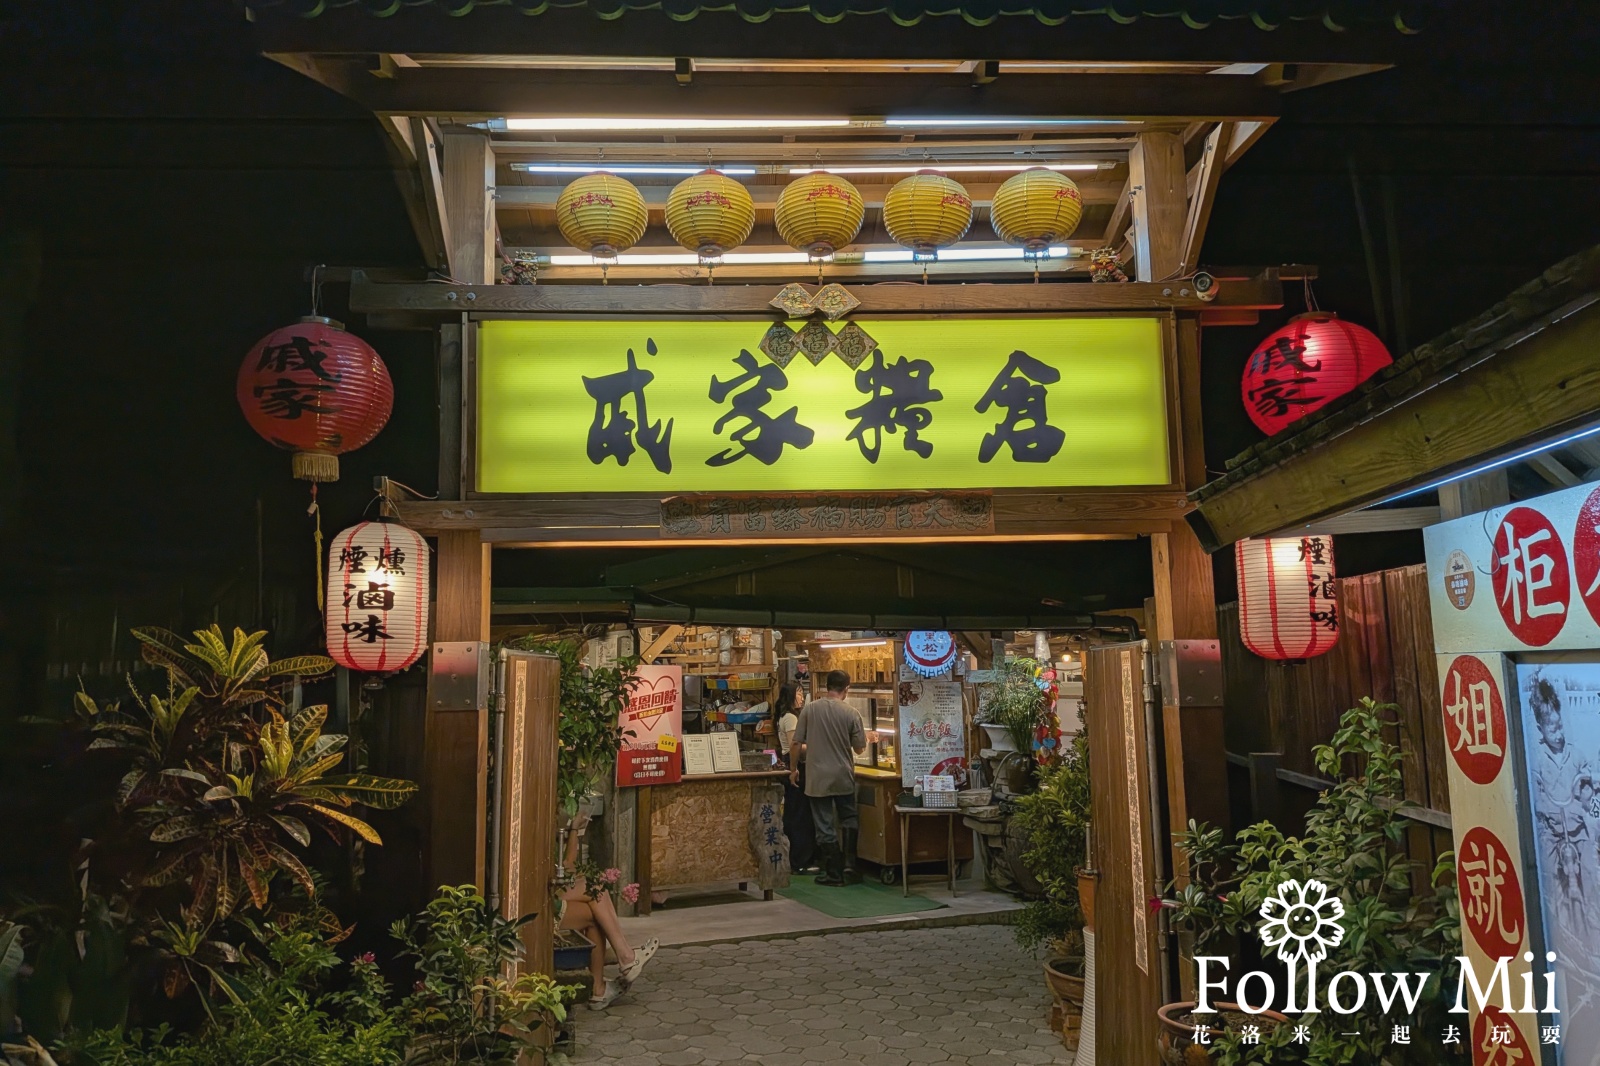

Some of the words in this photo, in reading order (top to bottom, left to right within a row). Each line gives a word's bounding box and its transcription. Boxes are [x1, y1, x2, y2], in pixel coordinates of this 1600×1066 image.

[801, 327, 829, 354] 福
[840, 331, 866, 358] 福
[922, 631, 938, 653] 黑松
[760, 804, 783, 870] 營業中
